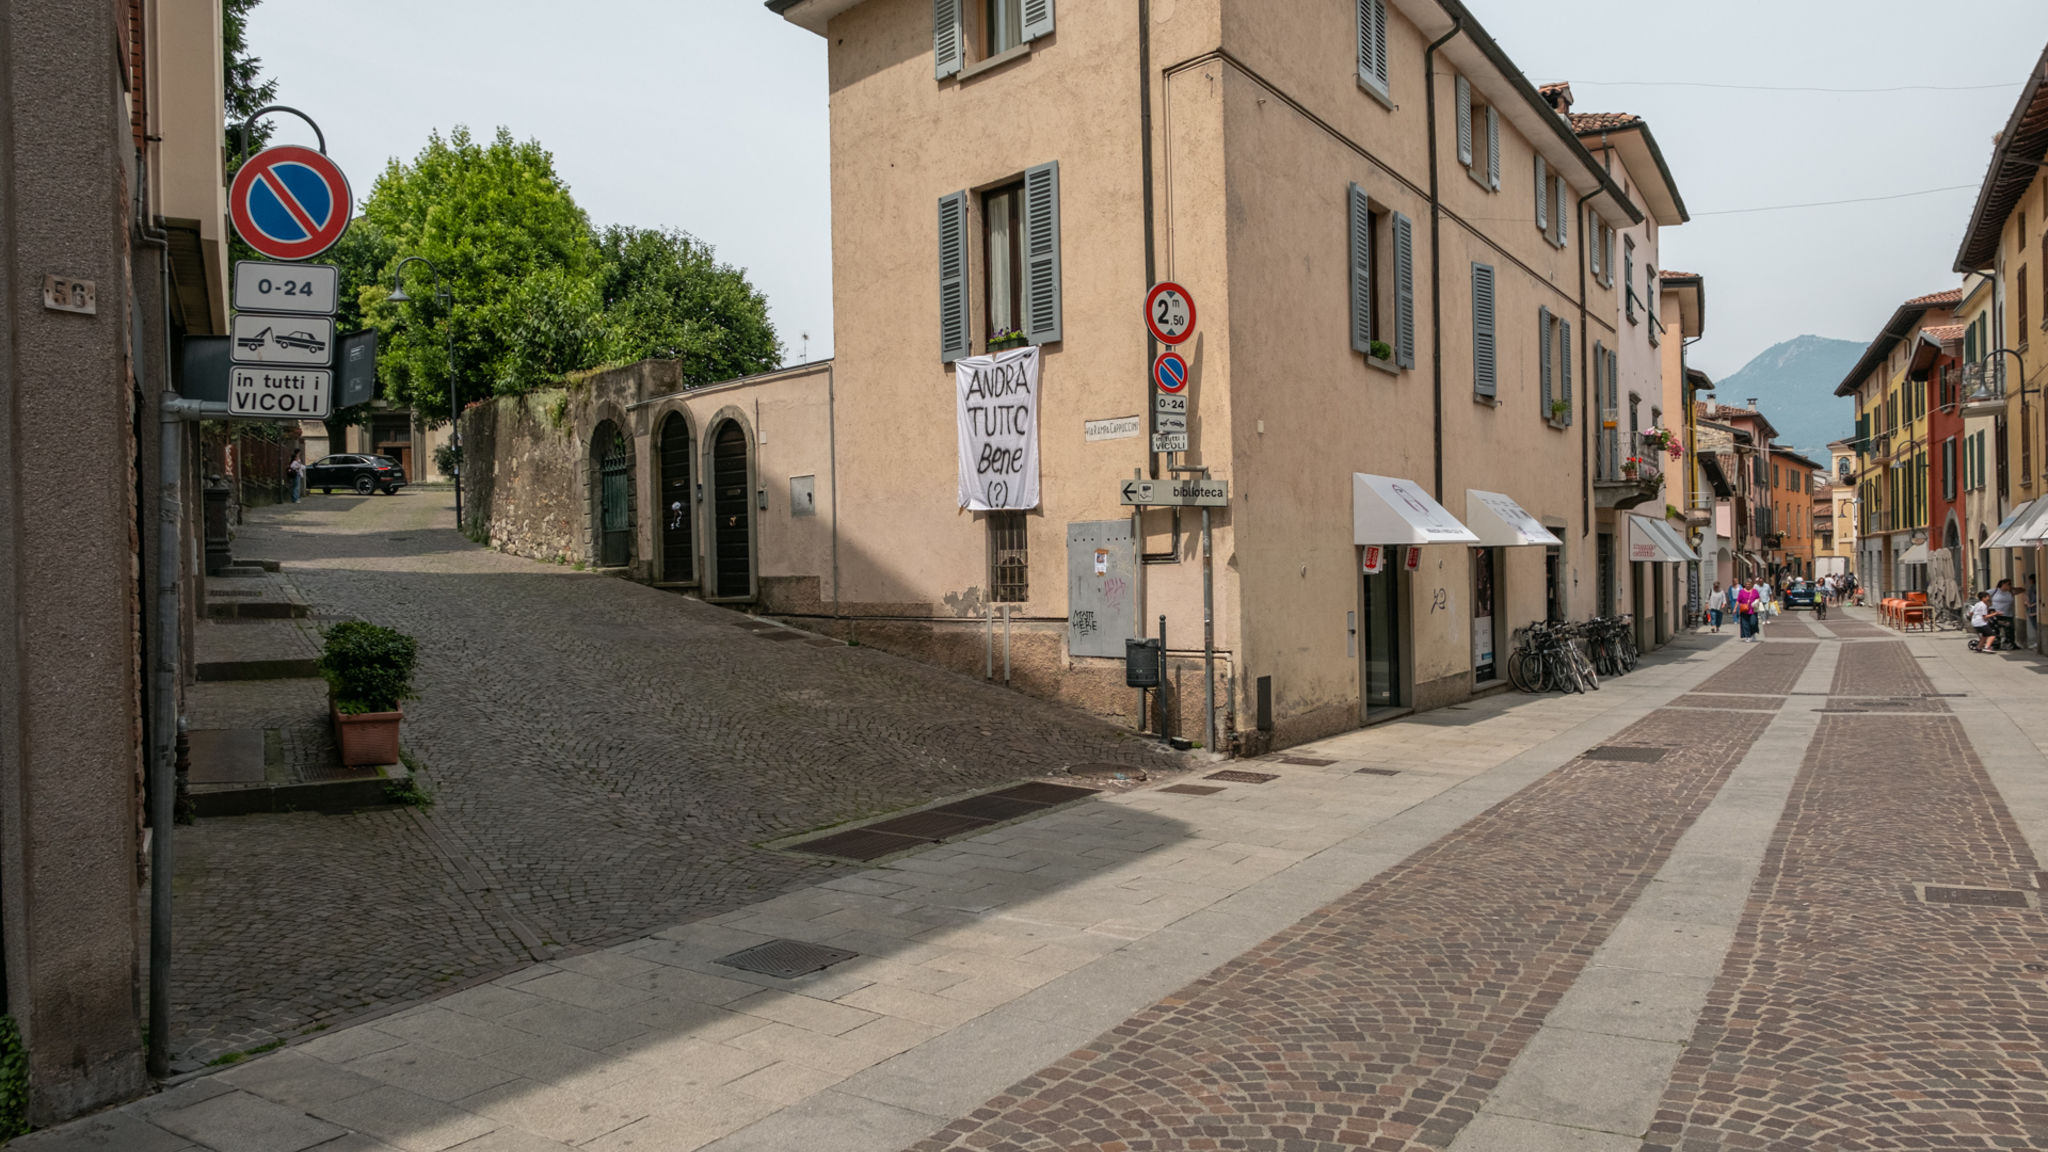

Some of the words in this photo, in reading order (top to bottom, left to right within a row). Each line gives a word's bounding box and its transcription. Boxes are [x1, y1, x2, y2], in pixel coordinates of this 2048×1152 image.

[258, 278, 313, 297] 0-24
[1158, 299, 1169, 324] 2
[237, 373, 253, 388] in
[264, 374, 305, 390] tutti
[314, 376, 320, 390] i
[236, 391, 318, 412] VICOLI
[1158, 398, 1184, 409] 0-24
[1155, 442, 1186, 450] VICOLI
[977, 443, 1023, 475] Bene
[1173, 486, 1223, 498] biblioteca
